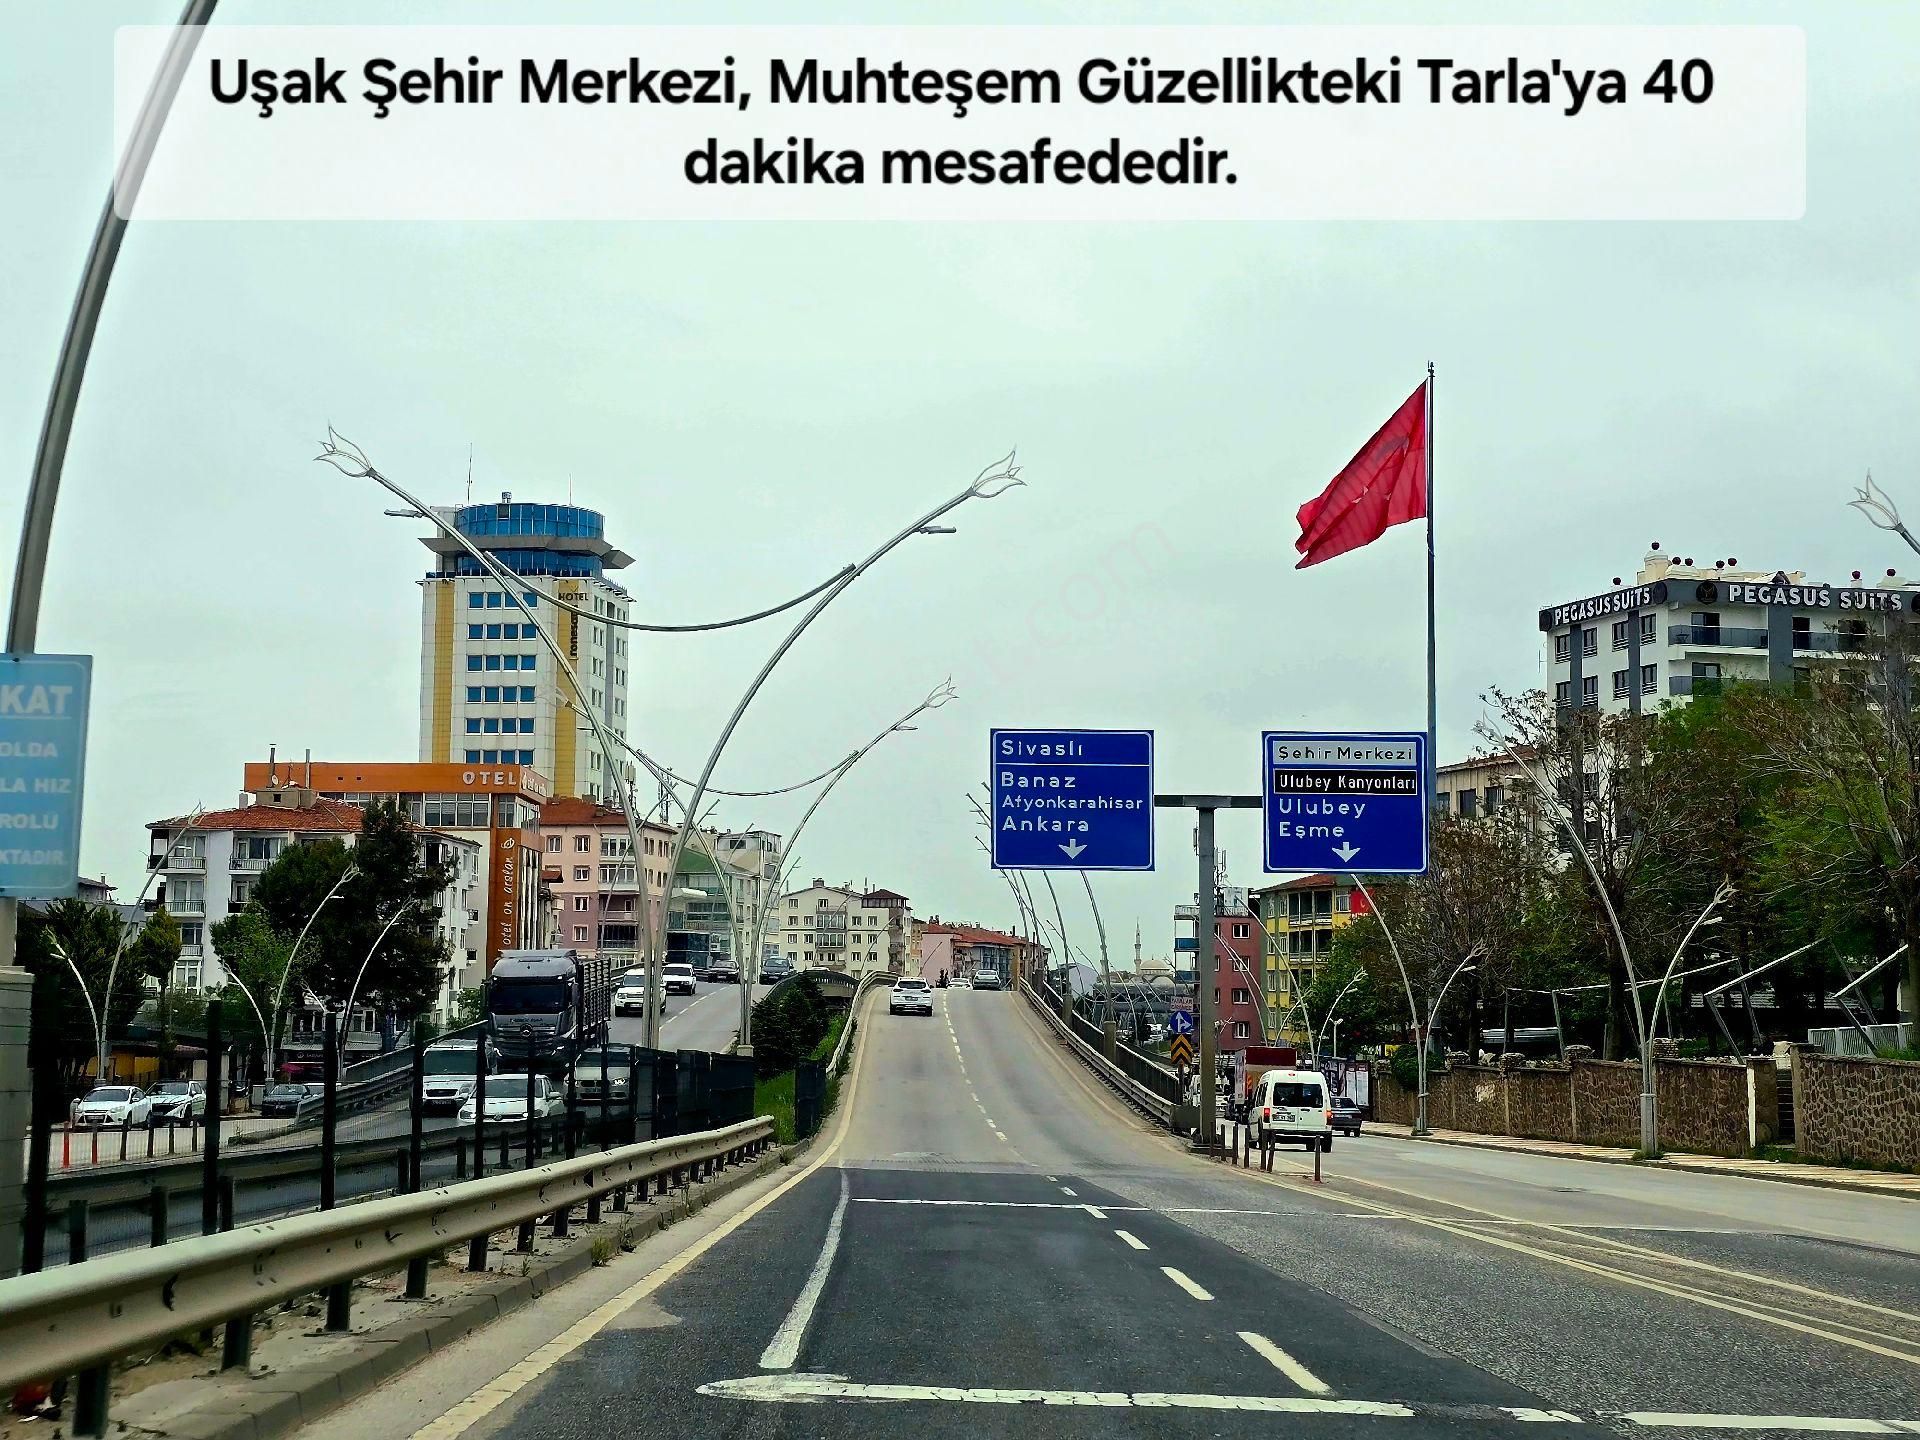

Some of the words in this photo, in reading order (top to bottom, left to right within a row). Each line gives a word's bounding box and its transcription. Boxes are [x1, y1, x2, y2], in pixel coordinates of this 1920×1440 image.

[558, 592, 589, 601] HOTEL
[1729, 584, 1831, 607] PEGASUS
[1555, 596, 1611, 626] PEGASUS
[1001, 739, 1083, 756] Sivaslı
[1279, 746, 1331, 760] Şehir
[1337, 746, 1412, 760] Merkezi
[462, 771, 517, 785] OTEL
[1001, 771, 1076, 788] Banaz
[1280, 774, 1332, 792] Ulubey
[1338, 775, 1415, 792] Kanyonları
[1002, 794, 1144, 812] Afyonkarahisar
[1279, 798, 1366, 819] Ulubey
[1002, 815, 1089, 832] Ankara
[1279, 821, 1345, 839] Eşme
